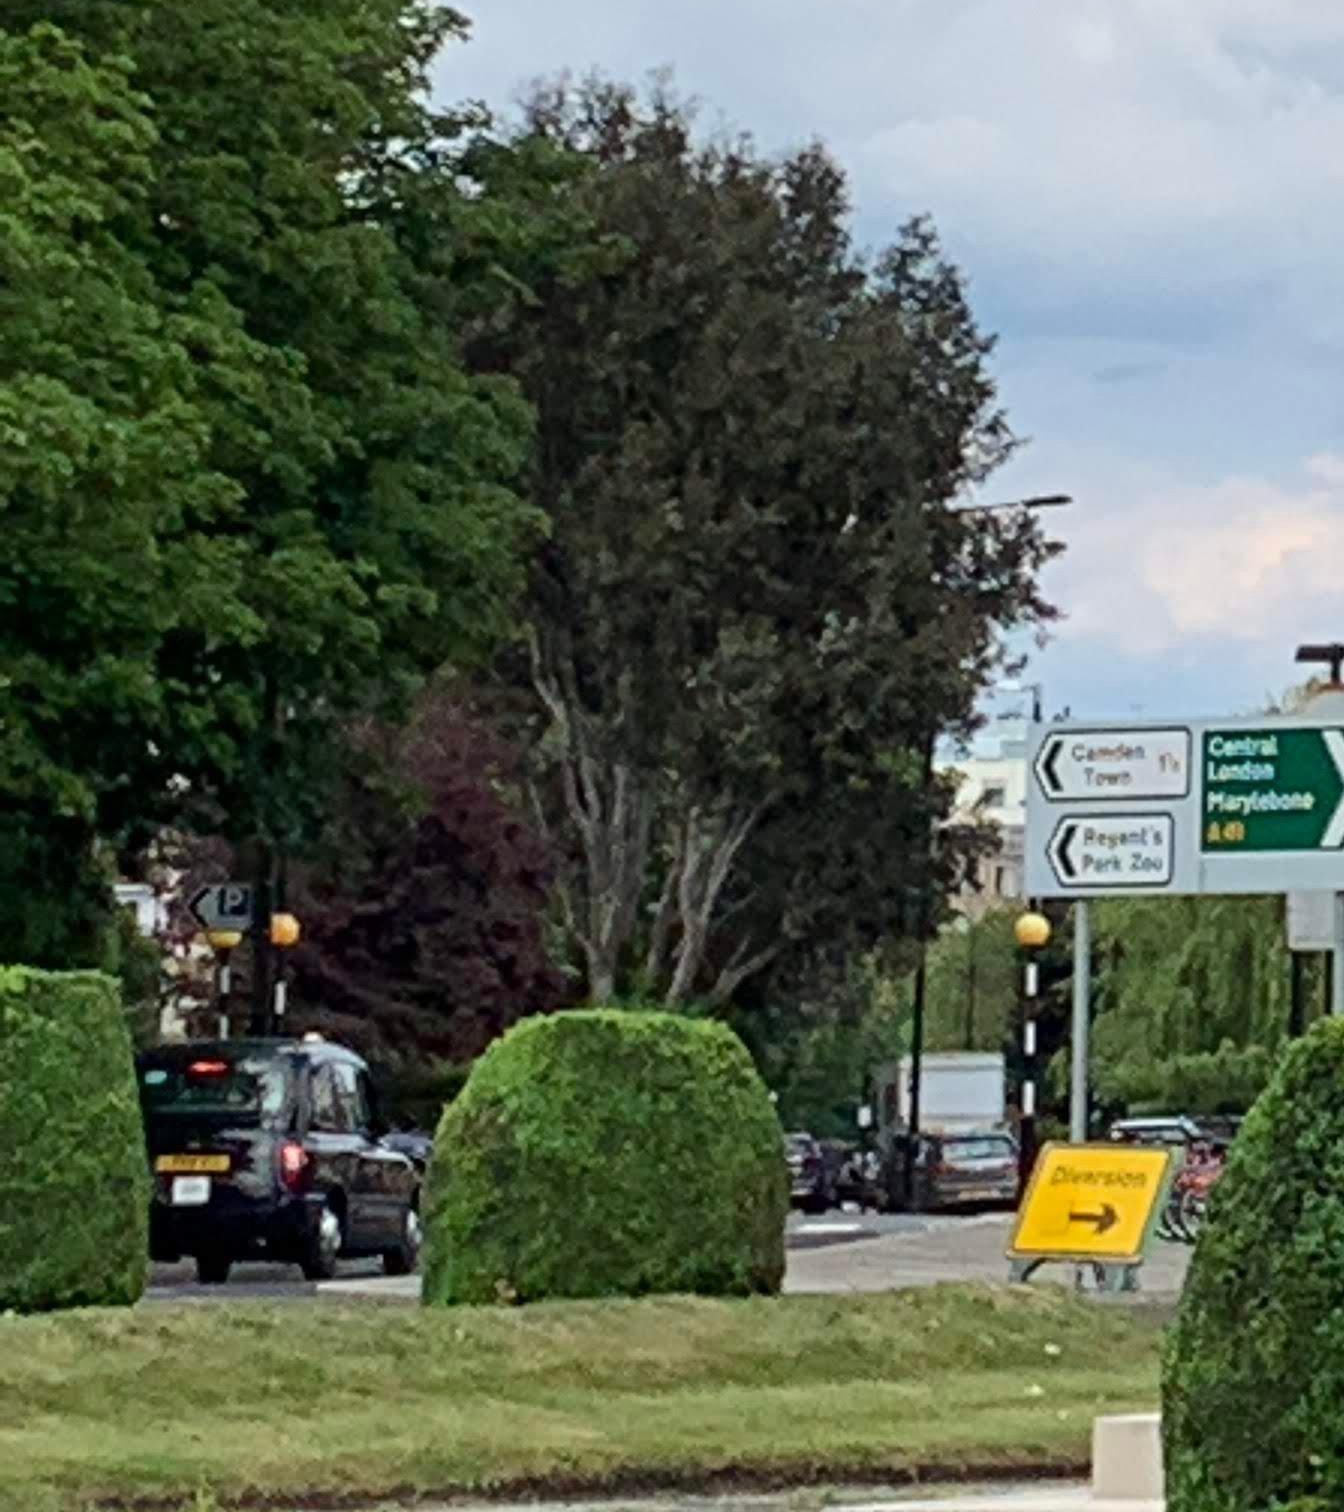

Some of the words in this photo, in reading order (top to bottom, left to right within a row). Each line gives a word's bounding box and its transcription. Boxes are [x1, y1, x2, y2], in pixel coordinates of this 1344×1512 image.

[1071, 742, 1146, 763] Camden
[1207, 734, 1279, 758] Central
[1083, 767, 1132, 787] Town
[1207, 760, 1275, 782] London
[1206, 789, 1315, 816] Marylebone
[1083, 825, 1163, 850] Regent's
[1082, 854, 1121, 874] Park
[223, 886, 242, 914] P
[1050, 1165, 1148, 1188] Diversion
